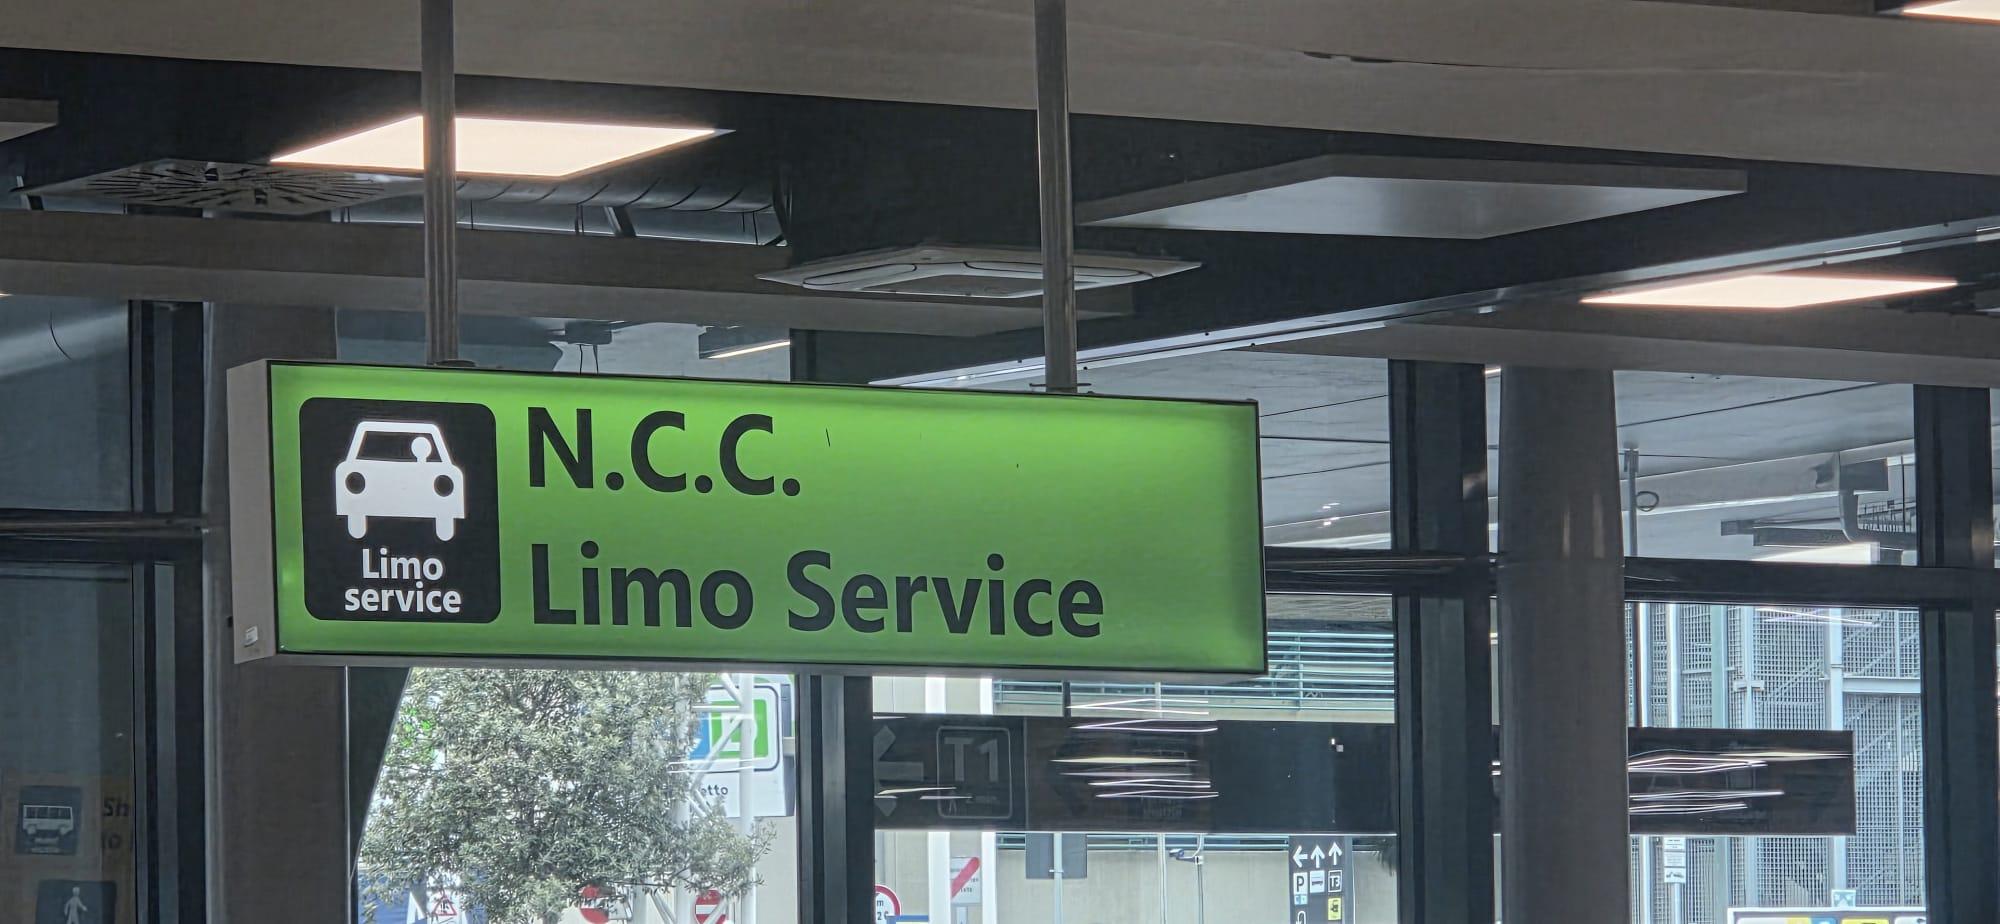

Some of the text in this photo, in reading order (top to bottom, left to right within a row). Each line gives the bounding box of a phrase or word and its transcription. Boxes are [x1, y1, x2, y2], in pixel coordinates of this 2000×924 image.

[528, 406, 801, 496] N.C.C.
[362, 547, 444, 581] Limo
[344, 581, 462, 613] service
[531, 540, 1104, 638] Limo Service
[943, 736, 999, 783] T1
[1296, 875, 1305, 893] P
